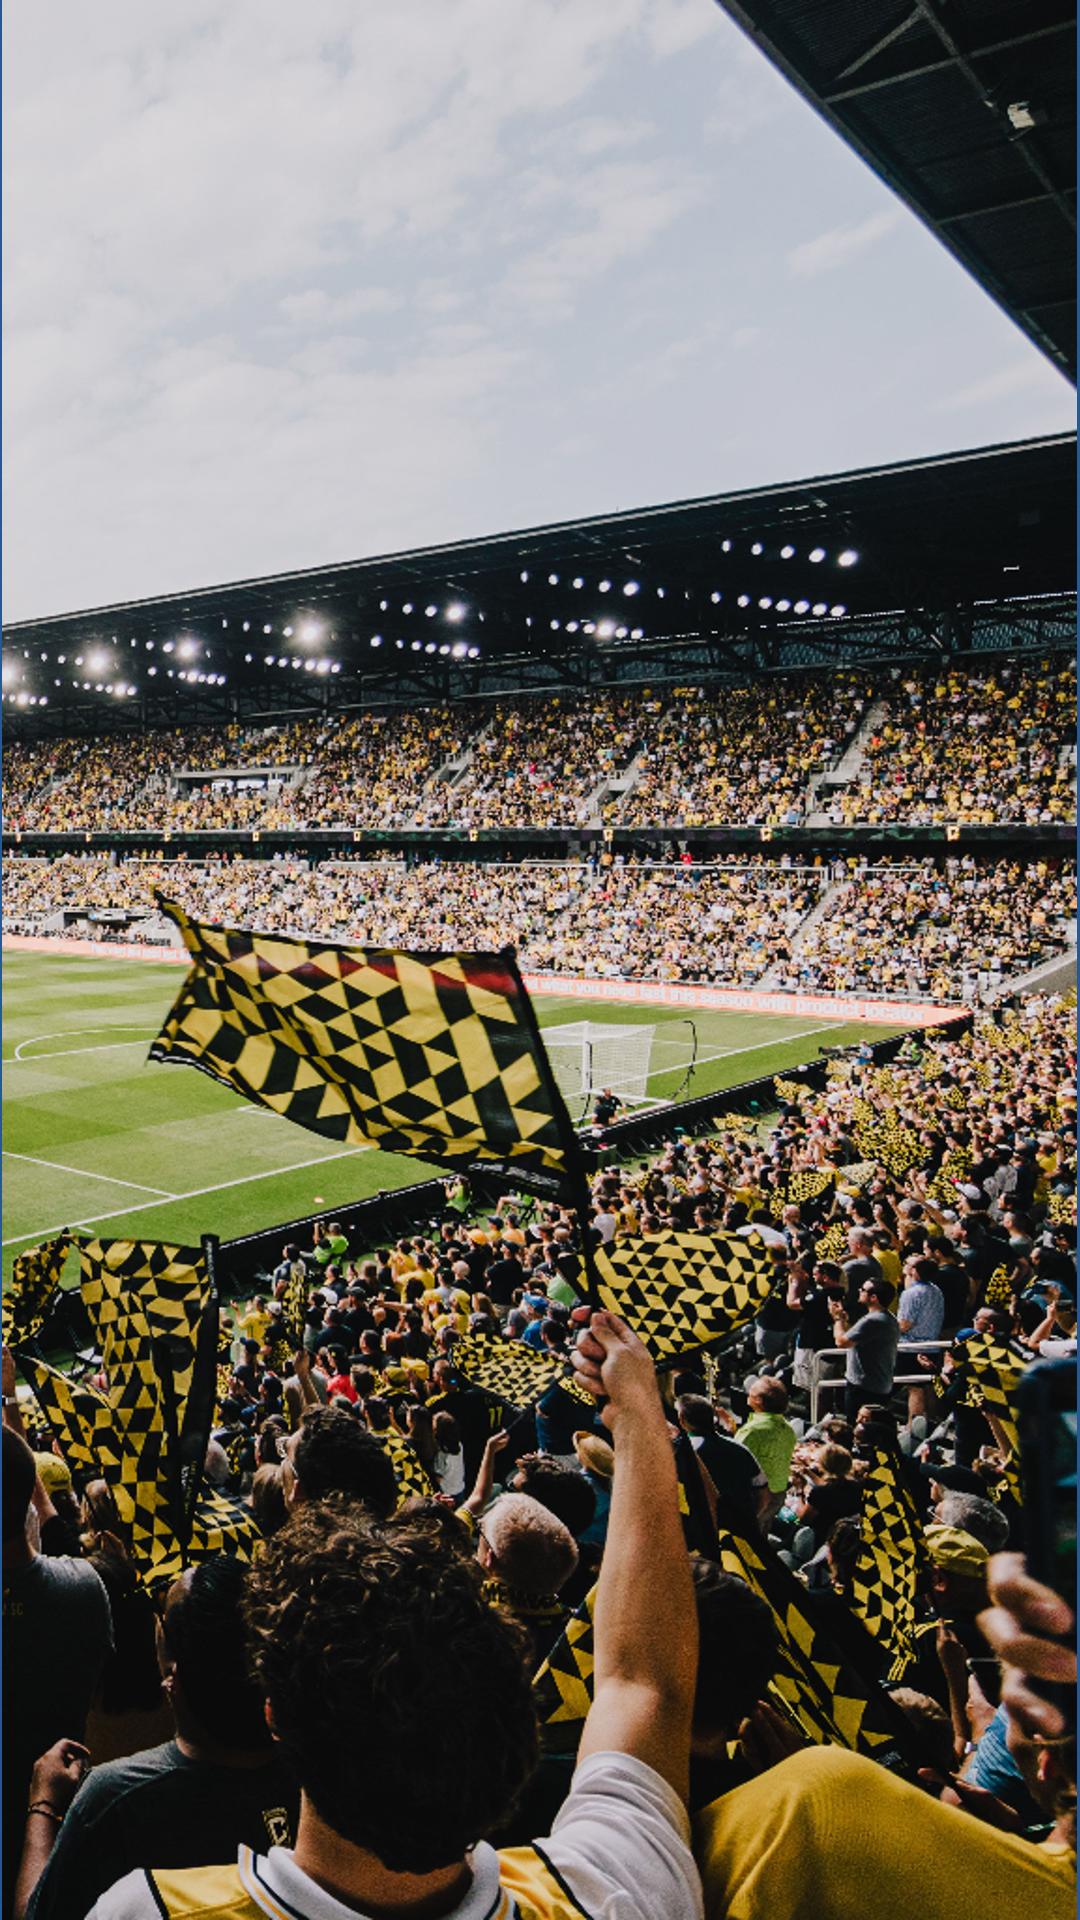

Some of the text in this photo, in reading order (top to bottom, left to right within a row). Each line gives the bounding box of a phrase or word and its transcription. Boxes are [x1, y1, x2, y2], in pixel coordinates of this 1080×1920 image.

[575, 981, 600, 998] you
[700, 993, 752, 1009] season
[757, 996, 788, 1011] with
[795, 1000, 860, 1018] product
[864, 1004, 924, 1021] locator
